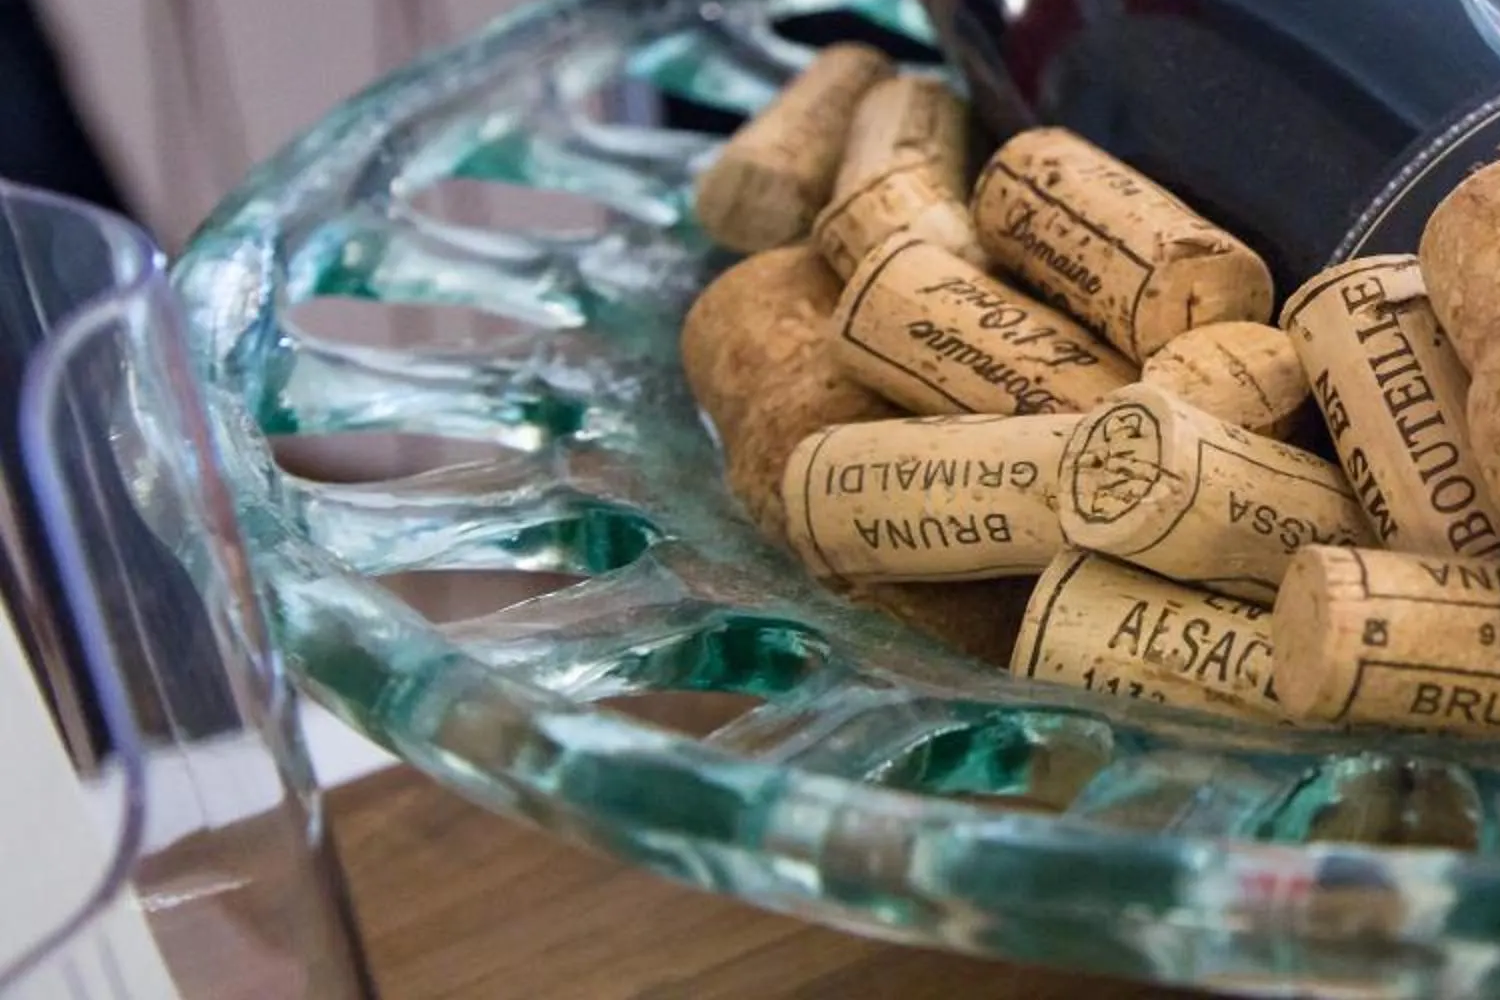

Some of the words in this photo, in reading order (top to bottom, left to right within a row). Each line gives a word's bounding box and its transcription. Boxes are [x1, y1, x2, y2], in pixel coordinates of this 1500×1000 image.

[998, 204, 1103, 295] Domaine
[1315, 368, 1351, 440] EN
[1341, 277, 1497, 553] BOUTEILLE
[824, 458, 1040, 497] GRIMALDI
[1347, 447, 1399, 540] MIS
[853, 512, 1014, 552] BRUNA
